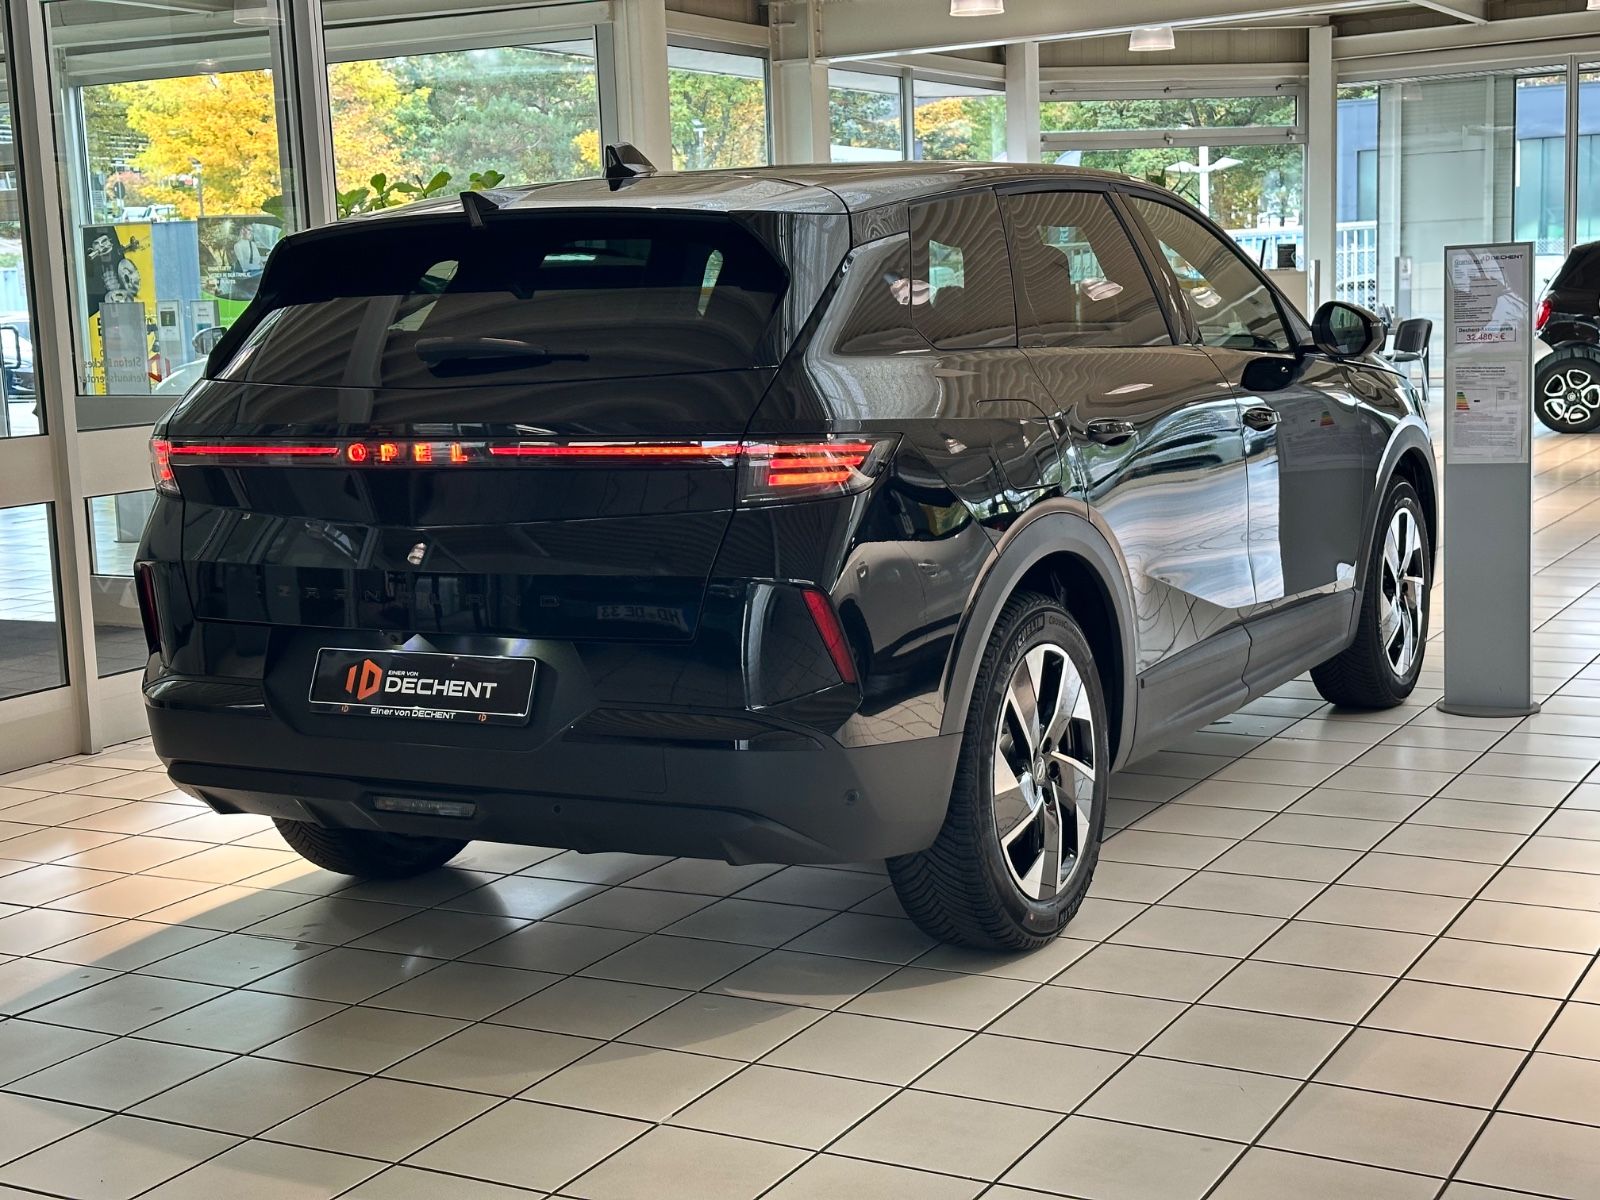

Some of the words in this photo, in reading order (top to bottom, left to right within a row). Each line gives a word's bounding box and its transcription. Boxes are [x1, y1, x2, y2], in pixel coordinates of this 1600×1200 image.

[347, 442, 469, 462] OPEL
[1009, 612, 1045, 662] MICHELIN
[384, 676, 497, 698] DECHENT
[370, 707, 394, 716] Einer
[394, 709, 411, 717] von
[411, 709, 456, 719] DECHENT
